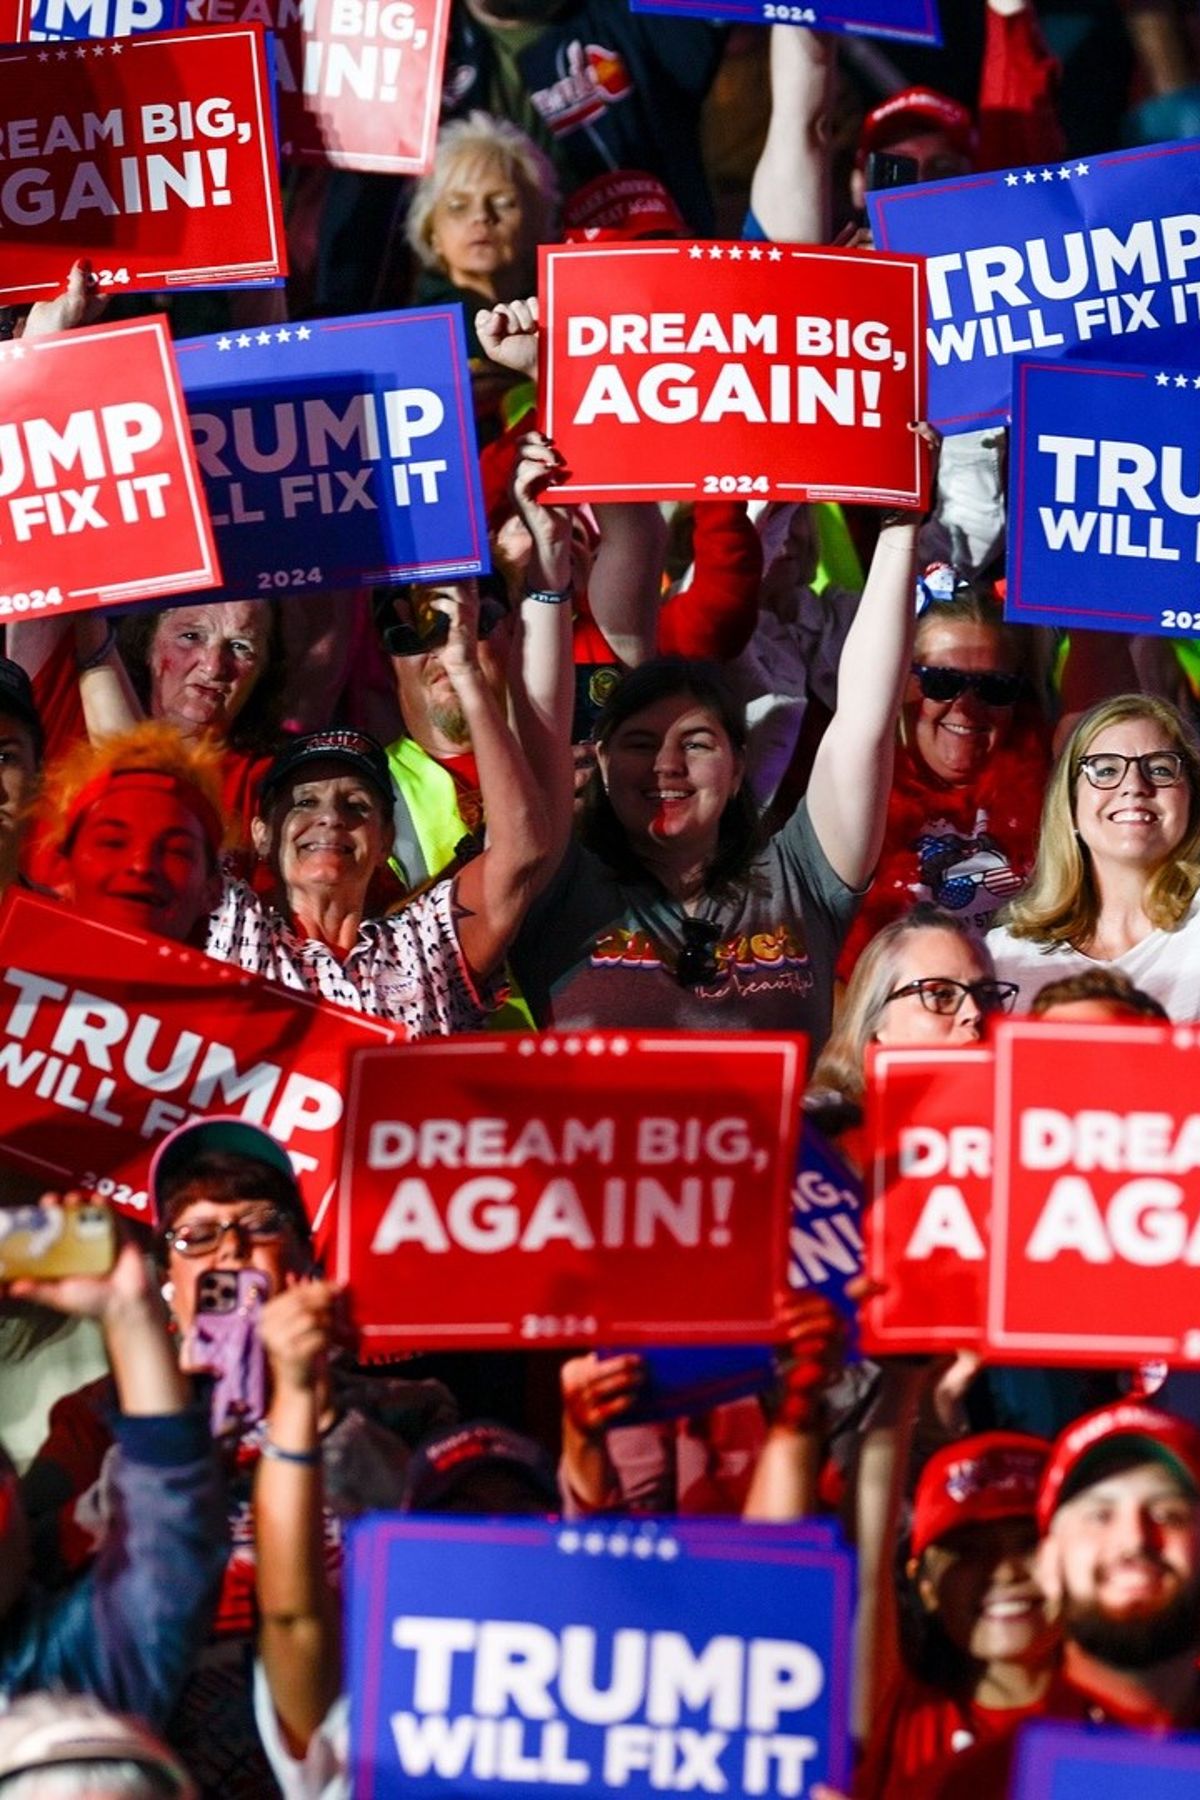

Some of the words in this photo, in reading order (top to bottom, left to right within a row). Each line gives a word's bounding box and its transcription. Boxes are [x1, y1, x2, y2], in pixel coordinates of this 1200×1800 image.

[330, 0, 428, 50] BIG,
[762, 3, 816, 23] 2024
[141, 97, 251, 144] BIG,
[0, 148, 232, 228] GAIN!
[567, 313, 779, 357] DREAM
[796, 316, 908, 371] BIG,
[926, 312, 1063, 367] WILL
[1074, 292, 1161, 341] FIX
[572, 363, 881, 428] AGAIN!
[190, 388, 444, 477] RUMP
[8, 484, 109, 543] FIX
[116, 473, 171, 524] IT
[280, 467, 378, 519] FIX
[392, 460, 447, 507] IT
[703, 475, 769, 493] 2024
[1038, 507, 1179, 562] WILL
[0, 586, 64, 615] 2024
[257, 567, 324, 589] 2024
[5, 967, 344, 1142] TRUMP
[367, 1118, 615, 1169] DREAM
[636, 1117, 769, 1173] BIG,
[80, 1170, 149, 1210] 2024
[370, 1176, 735, 1254] AGAIN!
[392, 1617, 824, 1733] TRUMP
[392, 1711, 587, 1786] WILL
[603, 1721, 726, 1790] FIX
[743, 1733, 816, 1799] IT
